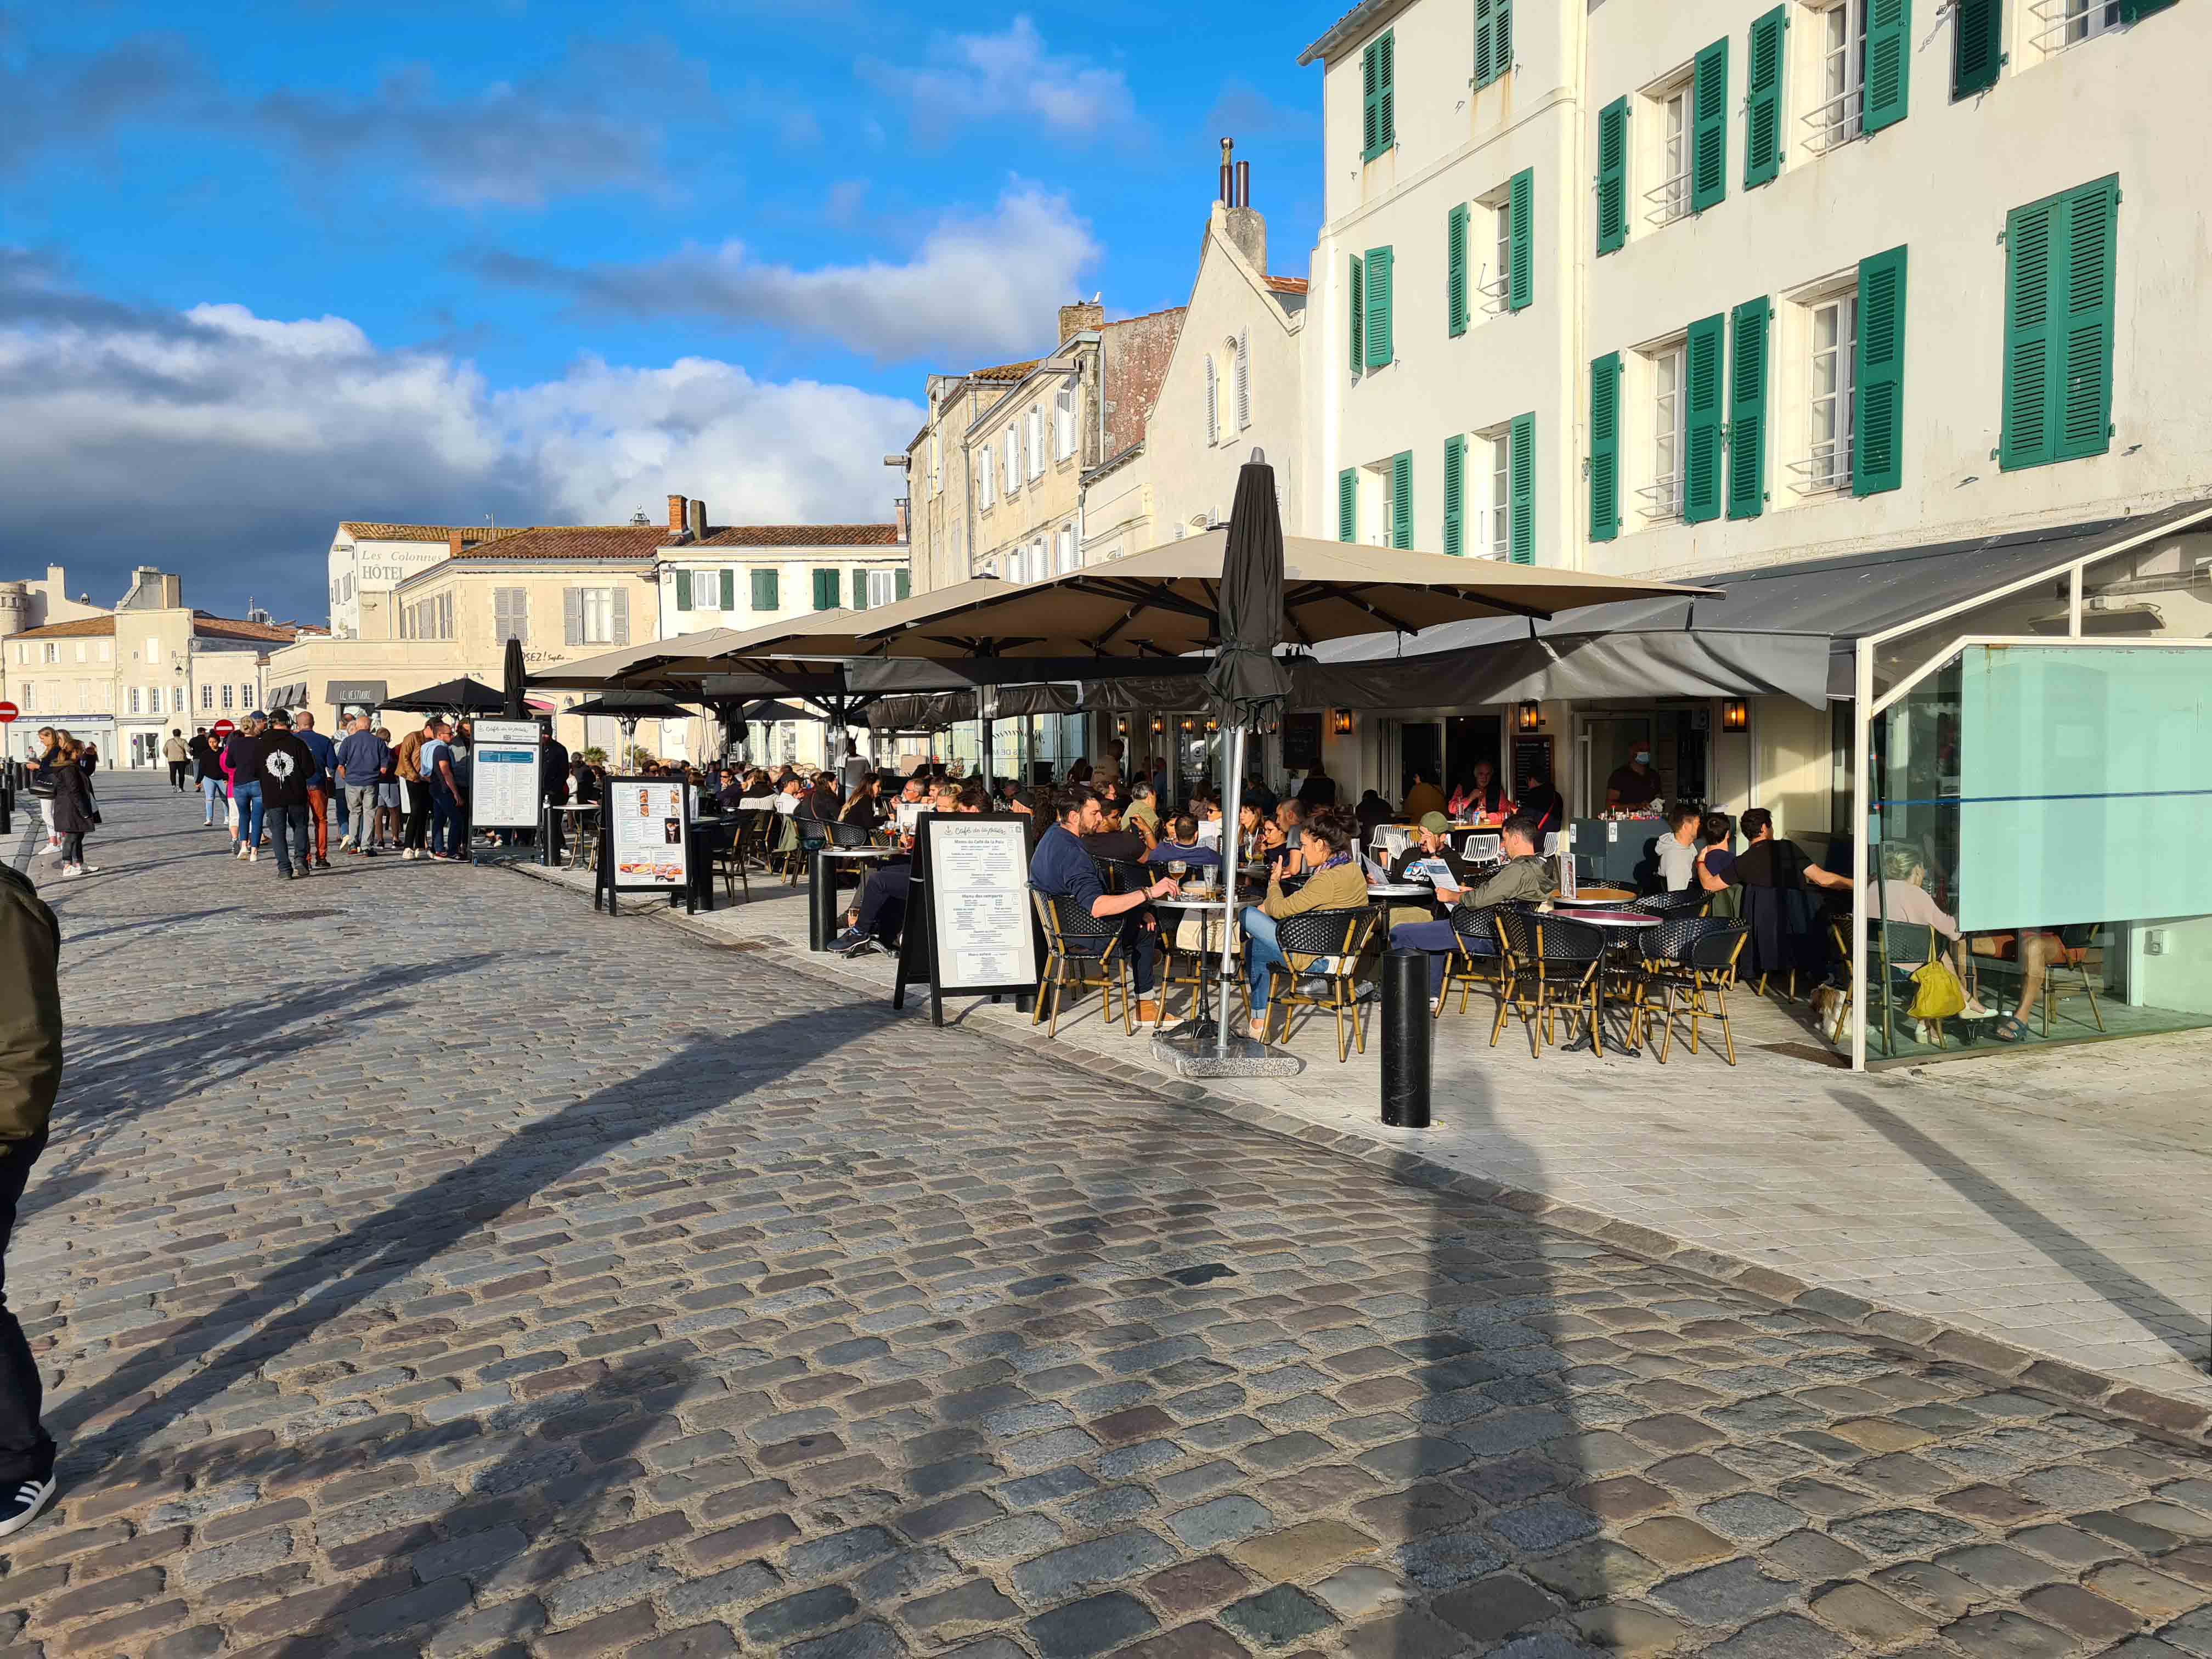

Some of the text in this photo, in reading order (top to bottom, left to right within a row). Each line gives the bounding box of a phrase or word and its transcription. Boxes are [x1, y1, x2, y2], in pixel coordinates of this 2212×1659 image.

[362, 550, 442, 562] Les Colonnes
[362, 564, 405, 580] HÔTEL
[339, 689, 371, 701] LE VESTIAIRE
